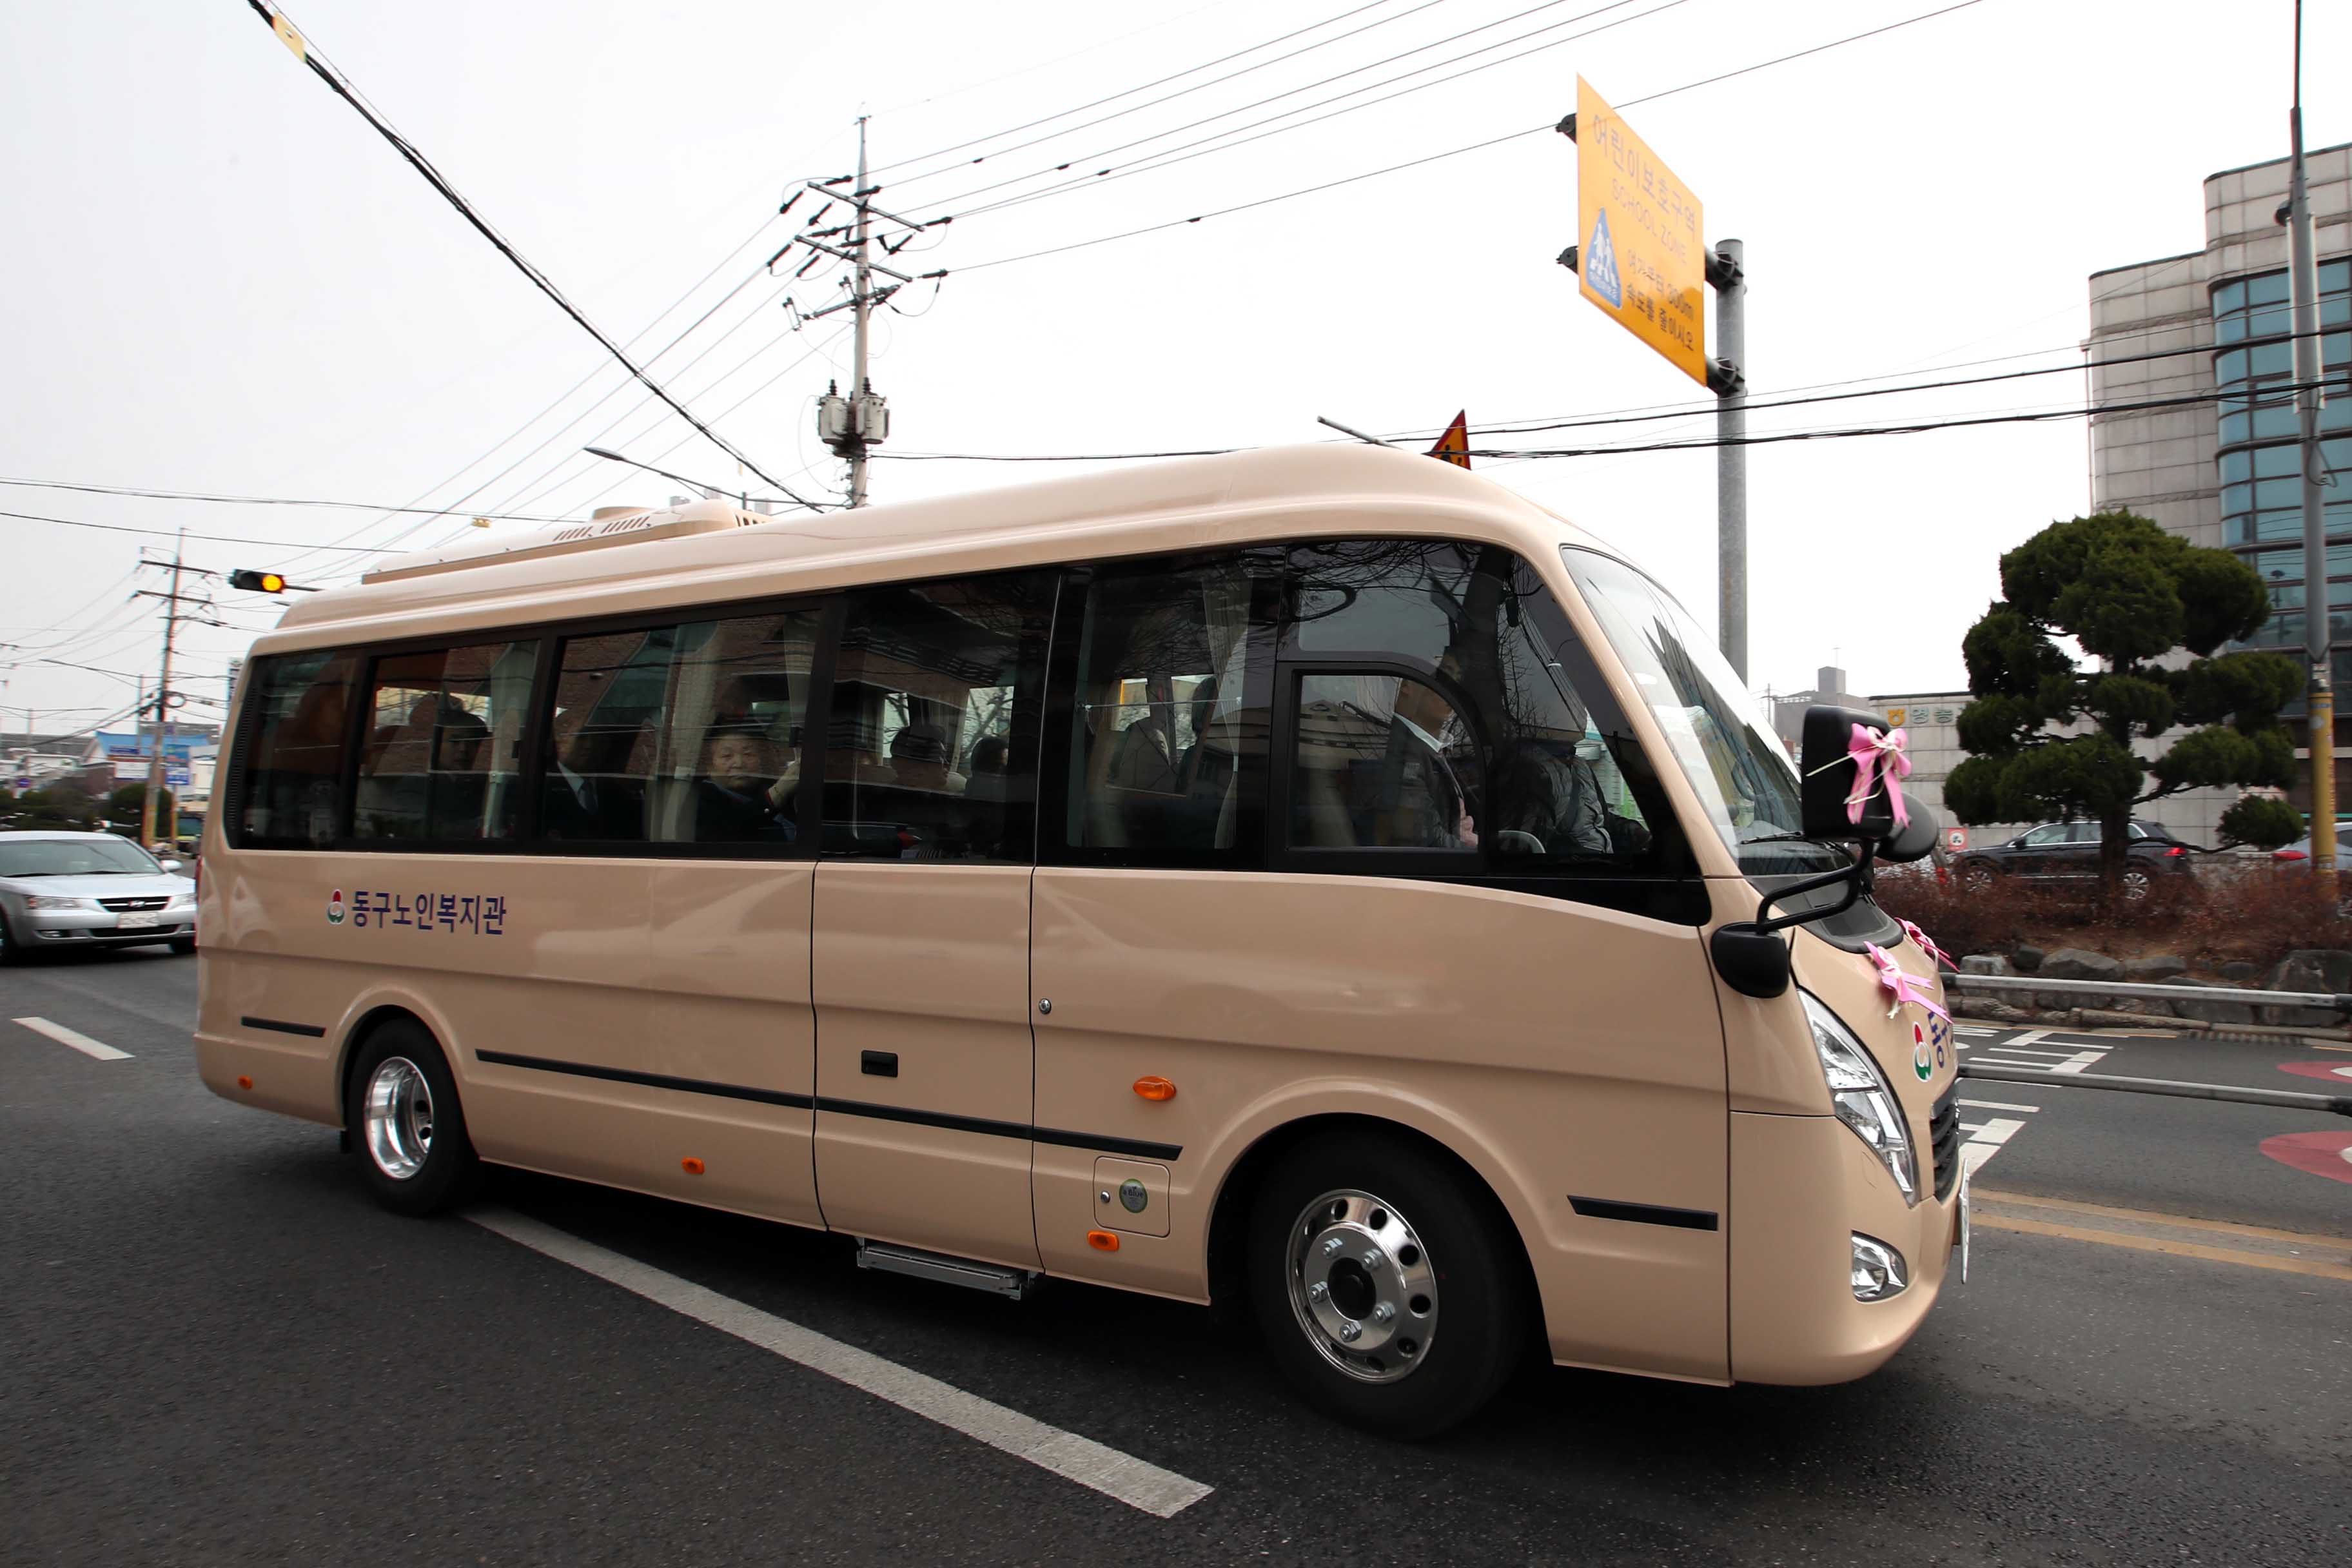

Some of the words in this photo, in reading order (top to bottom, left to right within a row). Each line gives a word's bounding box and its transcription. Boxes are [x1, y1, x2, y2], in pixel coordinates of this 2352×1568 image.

[1594, 115, 1696, 242] 어린이보호구역
[1611, 178, 1658, 237] SCHOOL
[1660, 224, 1687, 266] ZONE
[351, 890, 507, 935] 동구노인복지관
